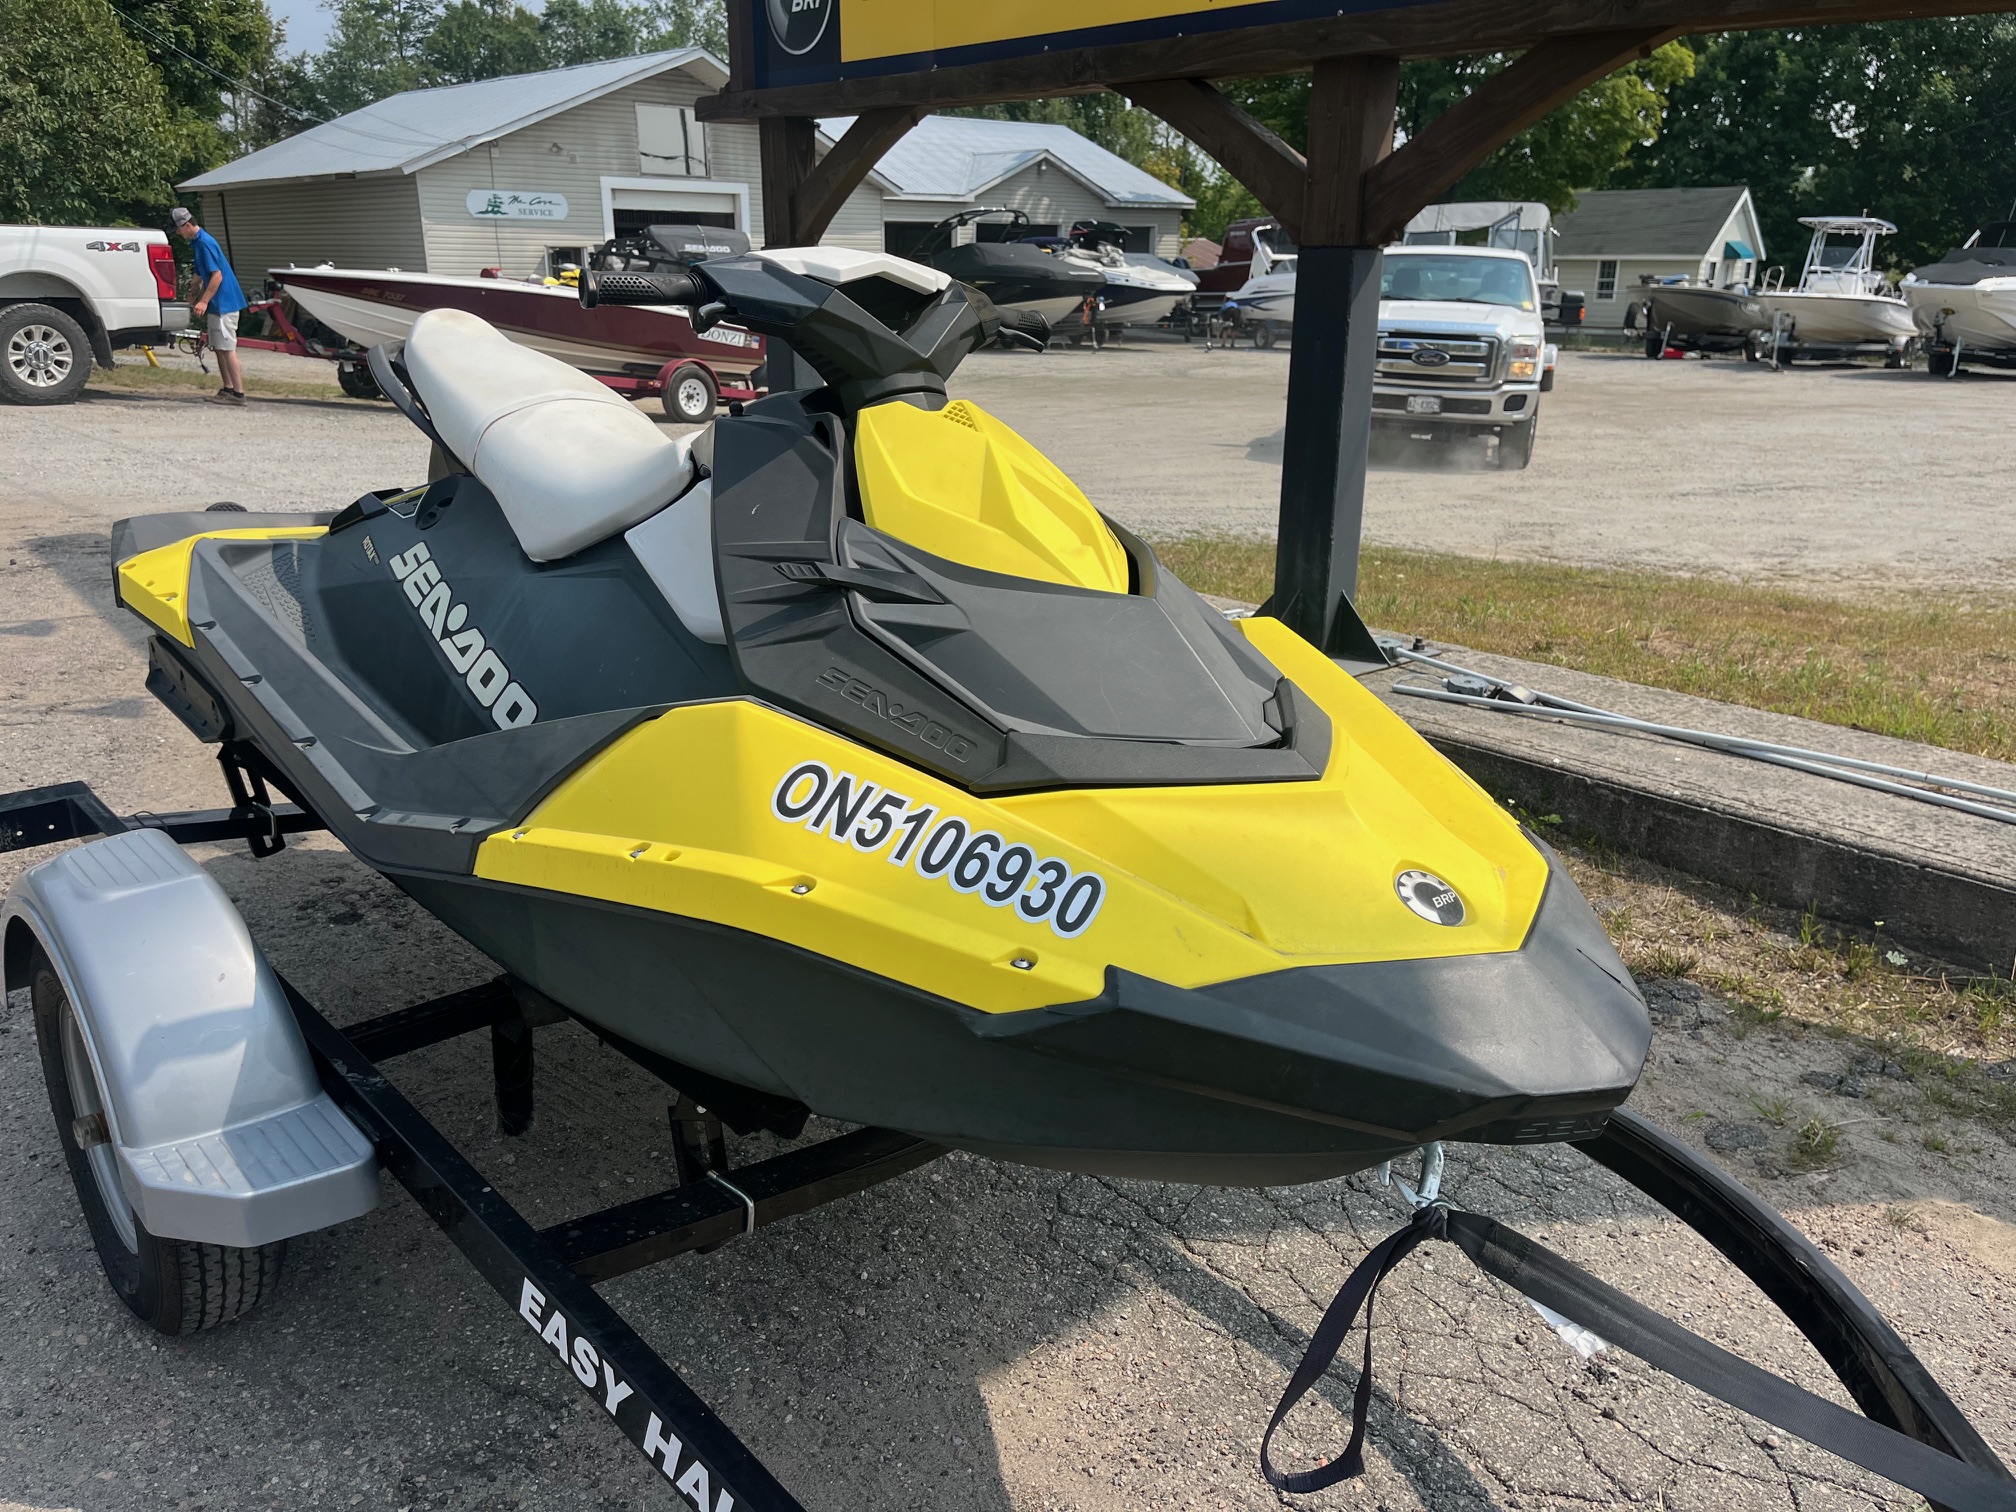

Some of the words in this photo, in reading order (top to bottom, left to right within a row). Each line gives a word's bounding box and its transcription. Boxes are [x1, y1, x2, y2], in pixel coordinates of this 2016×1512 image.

[518, 208, 554, 216] SERVICE
[774, 762, 1103, 935] ON5106930
[1432, 891, 1457, 908] BRP
[519, 1276, 634, 1417] EASY
[643, 1411, 735, 1512] HA
